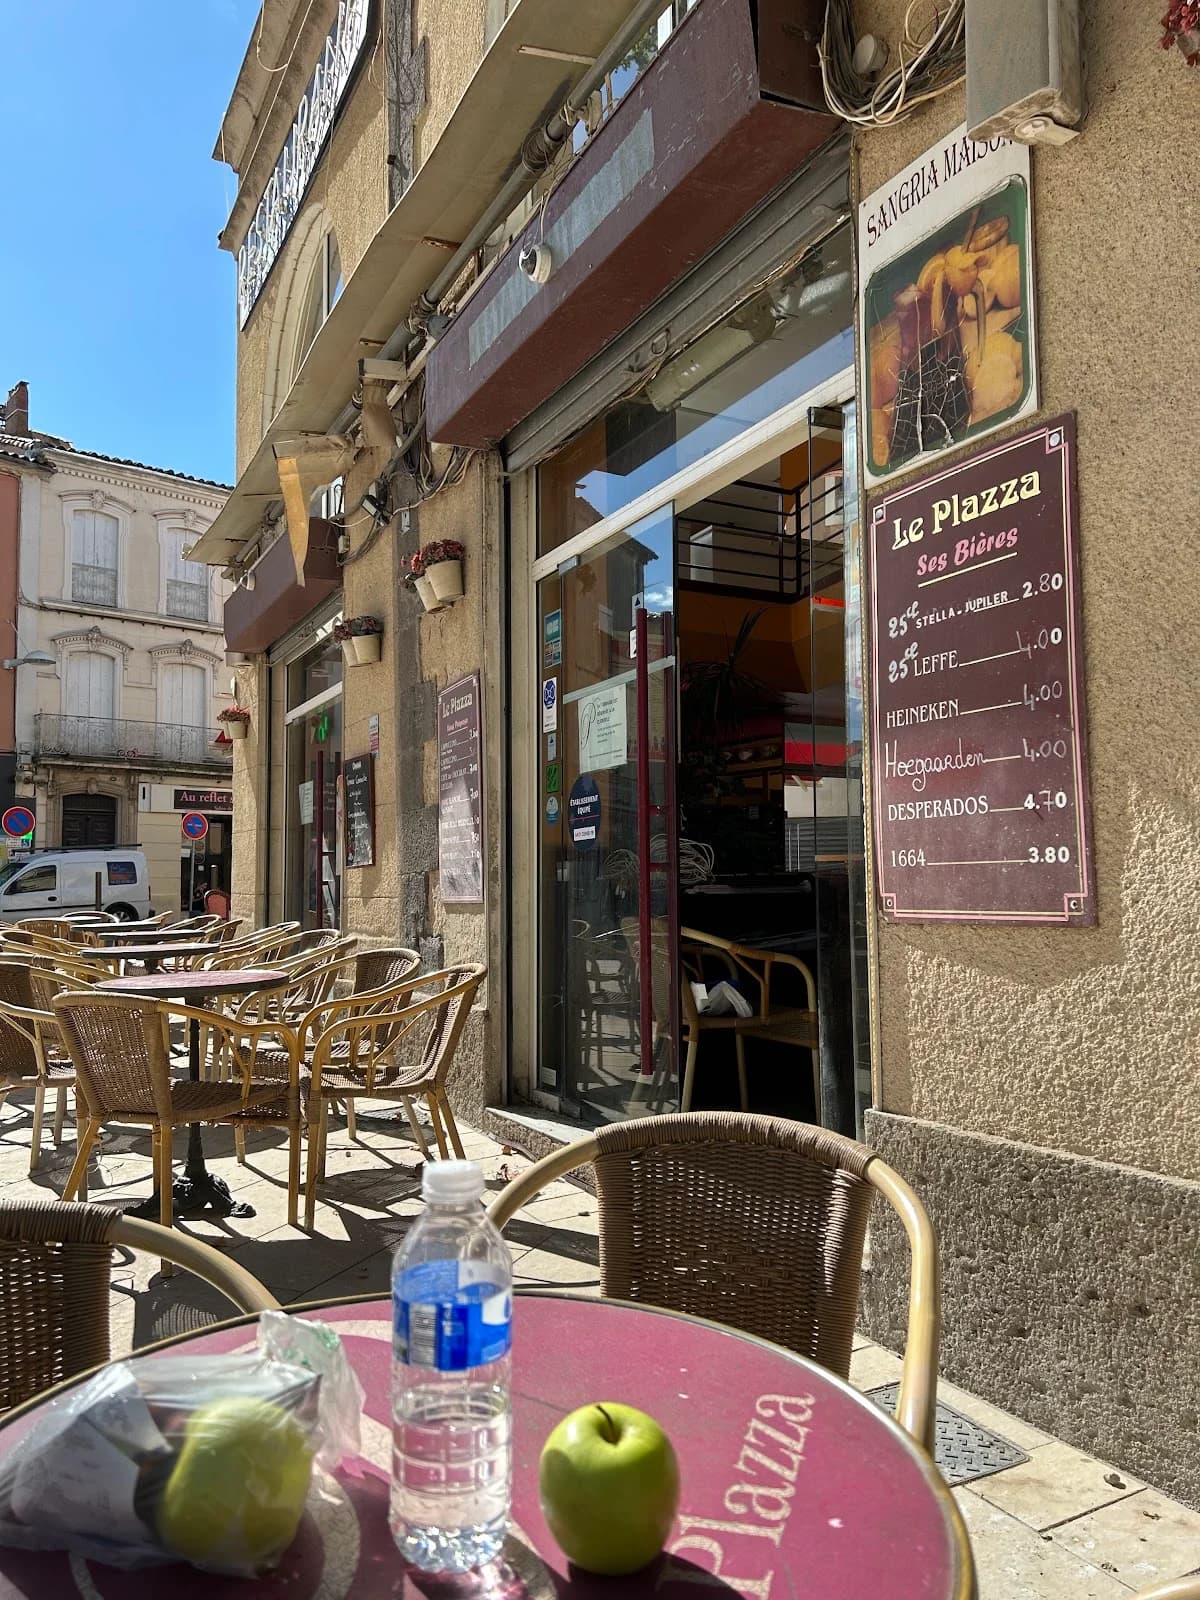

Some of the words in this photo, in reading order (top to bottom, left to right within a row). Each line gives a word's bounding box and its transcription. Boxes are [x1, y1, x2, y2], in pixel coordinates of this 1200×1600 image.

[867, 160, 940, 247] SANGRIA
[891, 515, 924, 550] Le
[931, 470, 1041, 535] Plazza
[916, 551, 948, 576] Ses
[953, 527, 1019, 566] Bières
[1022, 572, 1063, 599] 2.80
[913, 650, 959, 677] LEFFE
[1016, 627, 1063, 660] 4.00
[886, 699, 960, 728] HEINEKEN
[1023, 680, 1063, 711] 4.00
[885, 737, 986, 792] Hoegaarden
[1023, 738, 1067, 763] 4.00
[180, 791, 196, 802] Au
[199, 791, 228, 803] reflet
[888, 795, 989, 821] DESPERADOS
[1024, 790, 1067, 812] 4.70
[890, 848, 927, 868] 1664
[1028, 846, 1070, 864] 3.80
